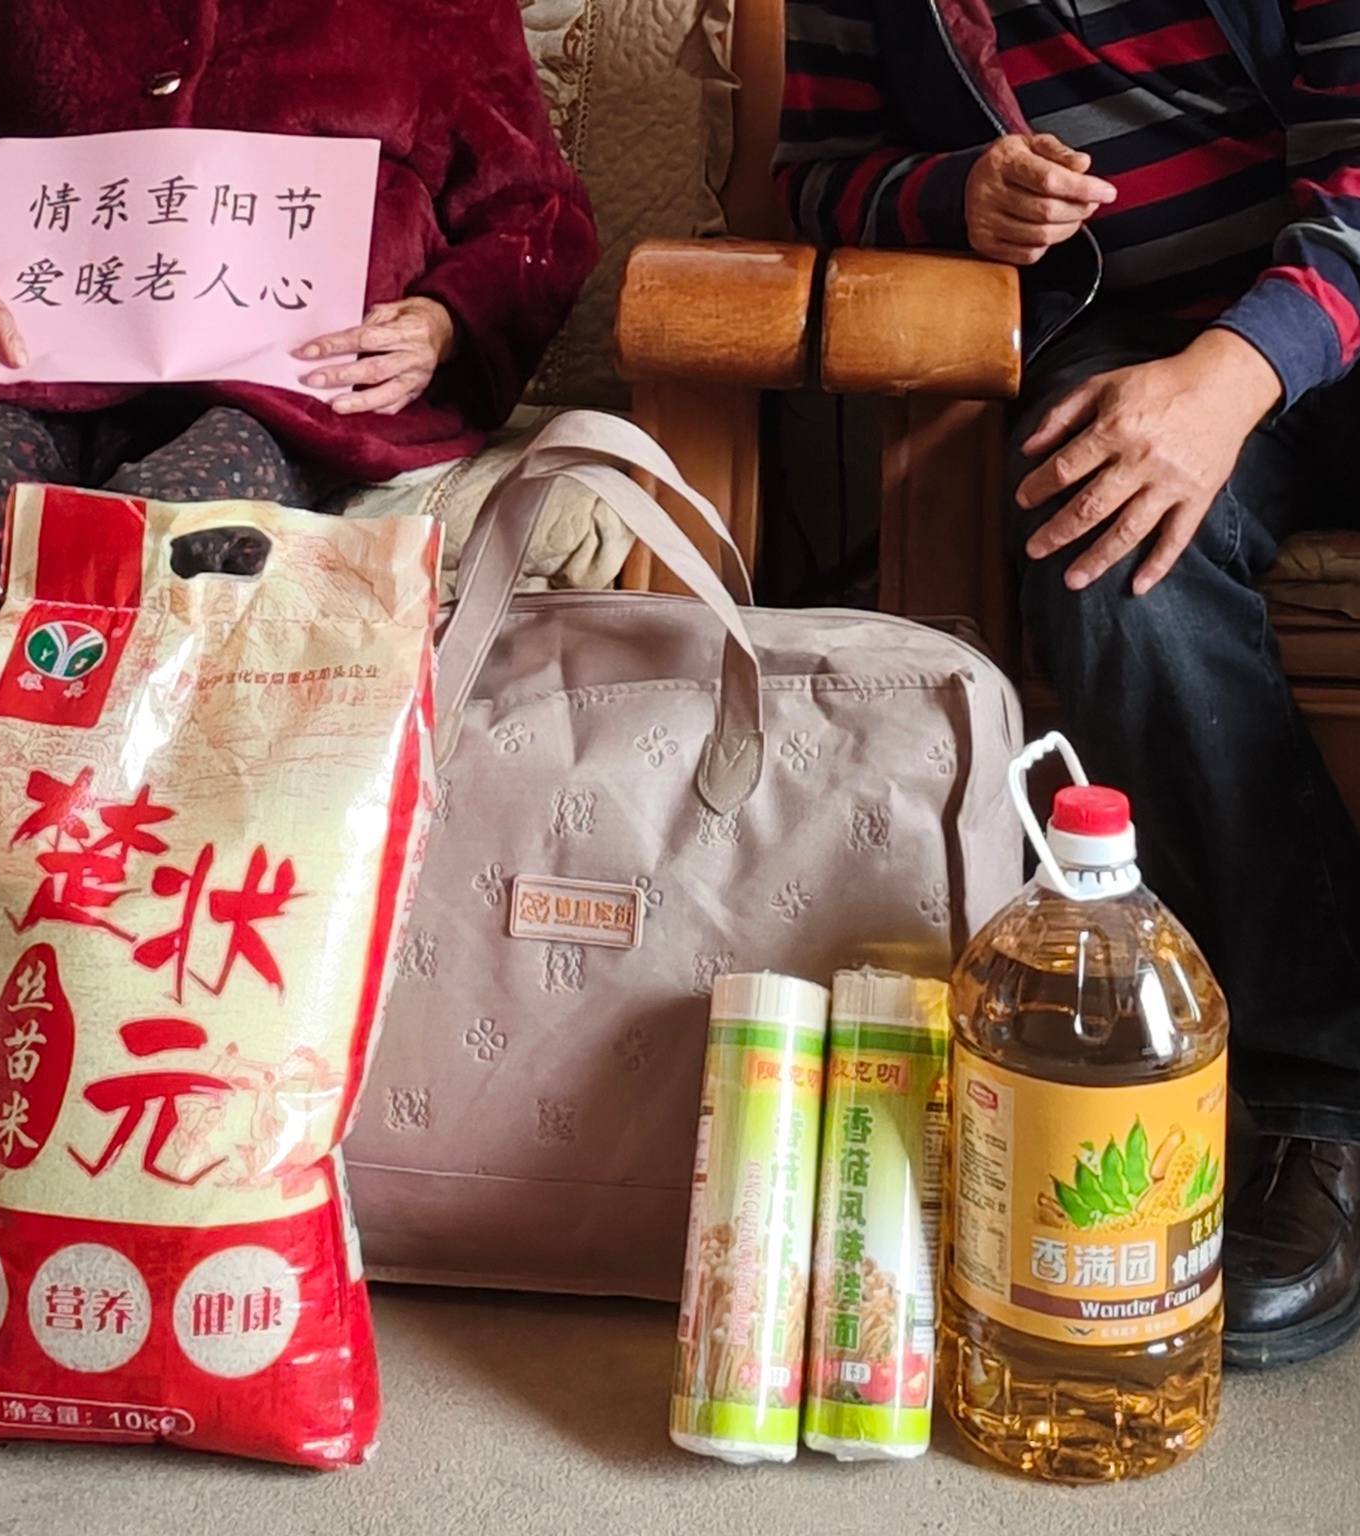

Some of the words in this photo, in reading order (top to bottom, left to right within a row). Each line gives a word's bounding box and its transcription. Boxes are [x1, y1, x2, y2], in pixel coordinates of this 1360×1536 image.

[29, 175, 322, 240] 情系重阳节
[10, 253, 313, 310] 爱暖老人心
[1032, 1236, 1156, 1288] 香满园
[44, 1284, 134, 1335] 营养
[192, 1286, 283, 1336] 健康
[1080, 1299, 1157, 1319] Wonder
[1164, 1281, 1200, 1309] Farm
